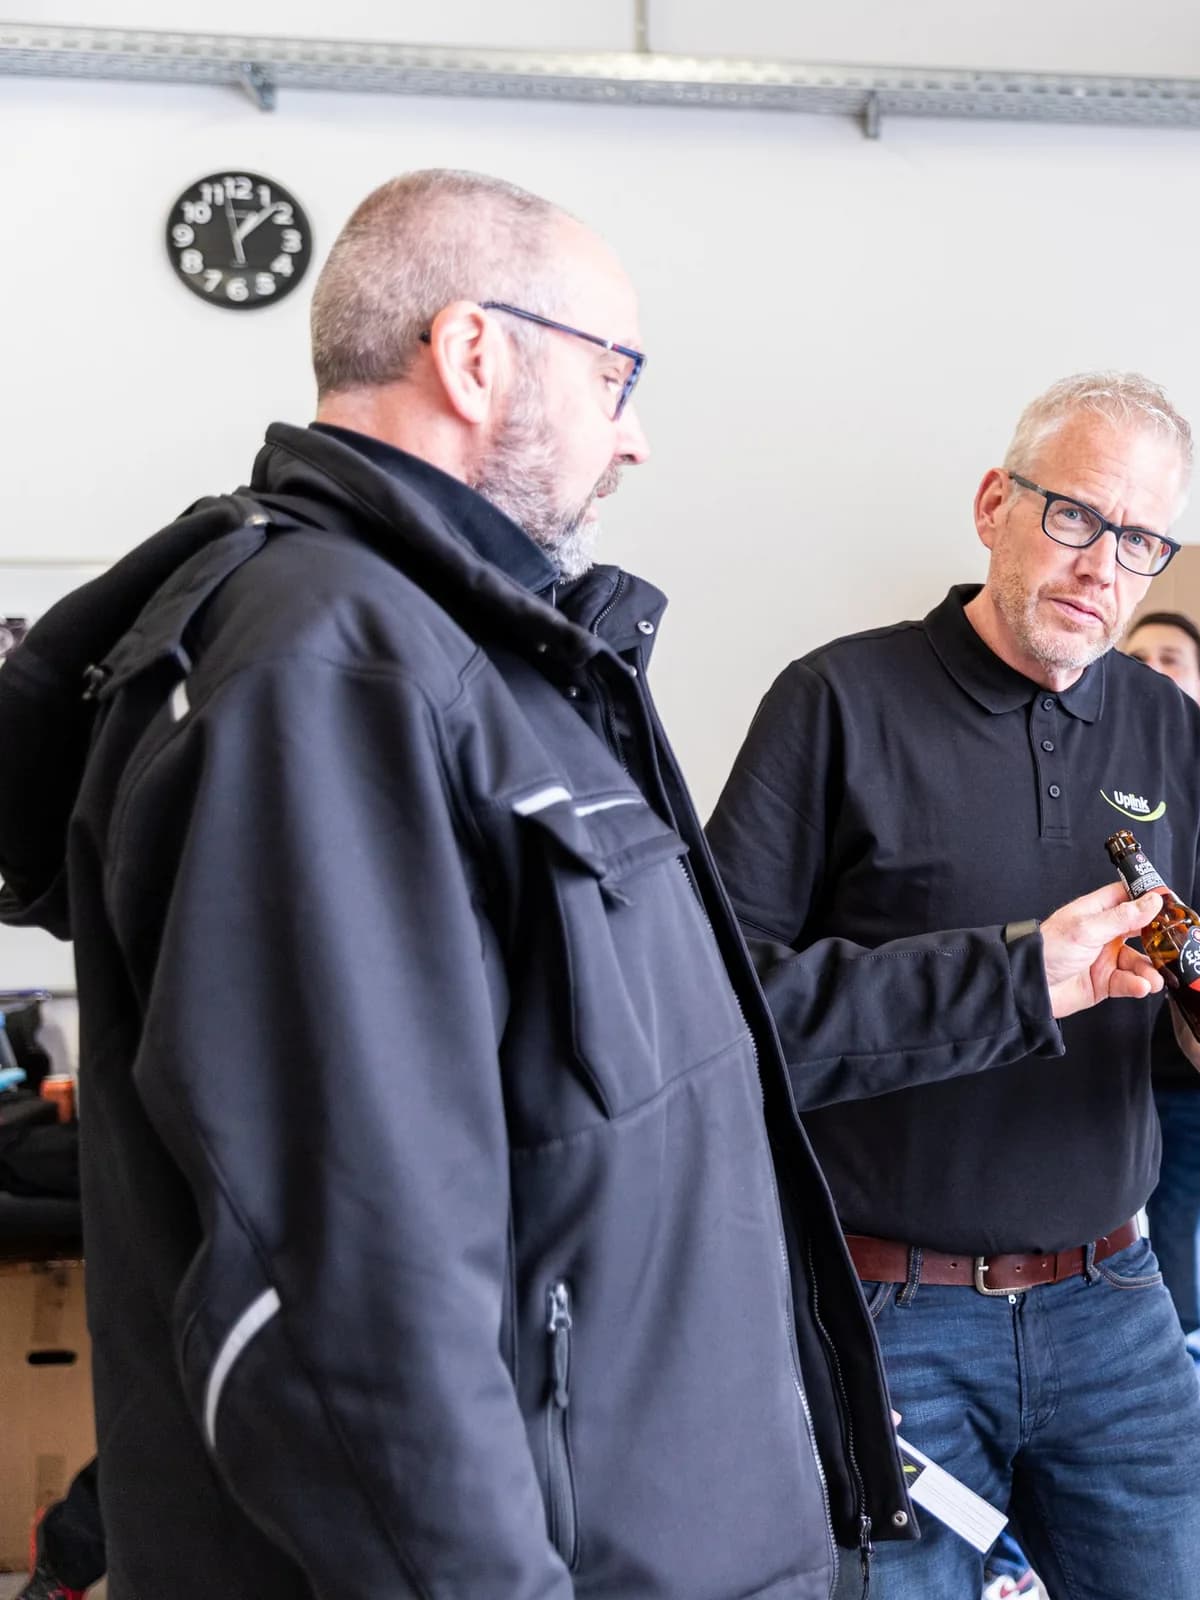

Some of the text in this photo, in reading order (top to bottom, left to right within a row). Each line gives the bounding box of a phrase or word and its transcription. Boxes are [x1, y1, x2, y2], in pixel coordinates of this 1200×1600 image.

[200, 182, 224, 206] 11
[223, 176, 253, 200] 12
[258, 185, 271, 207] 1
[182, 201, 212, 225] 10
[271, 201, 294, 225] 2
[172, 223, 194, 248] 9
[281, 229, 302, 253] 3
[180, 249, 203, 274] 8
[270, 253, 294, 277] 4
[203, 269, 222, 292] 7
[226, 278, 249, 302] 6
[255, 272, 276, 295] 5
[1113, 790, 1150, 812] Uplink
